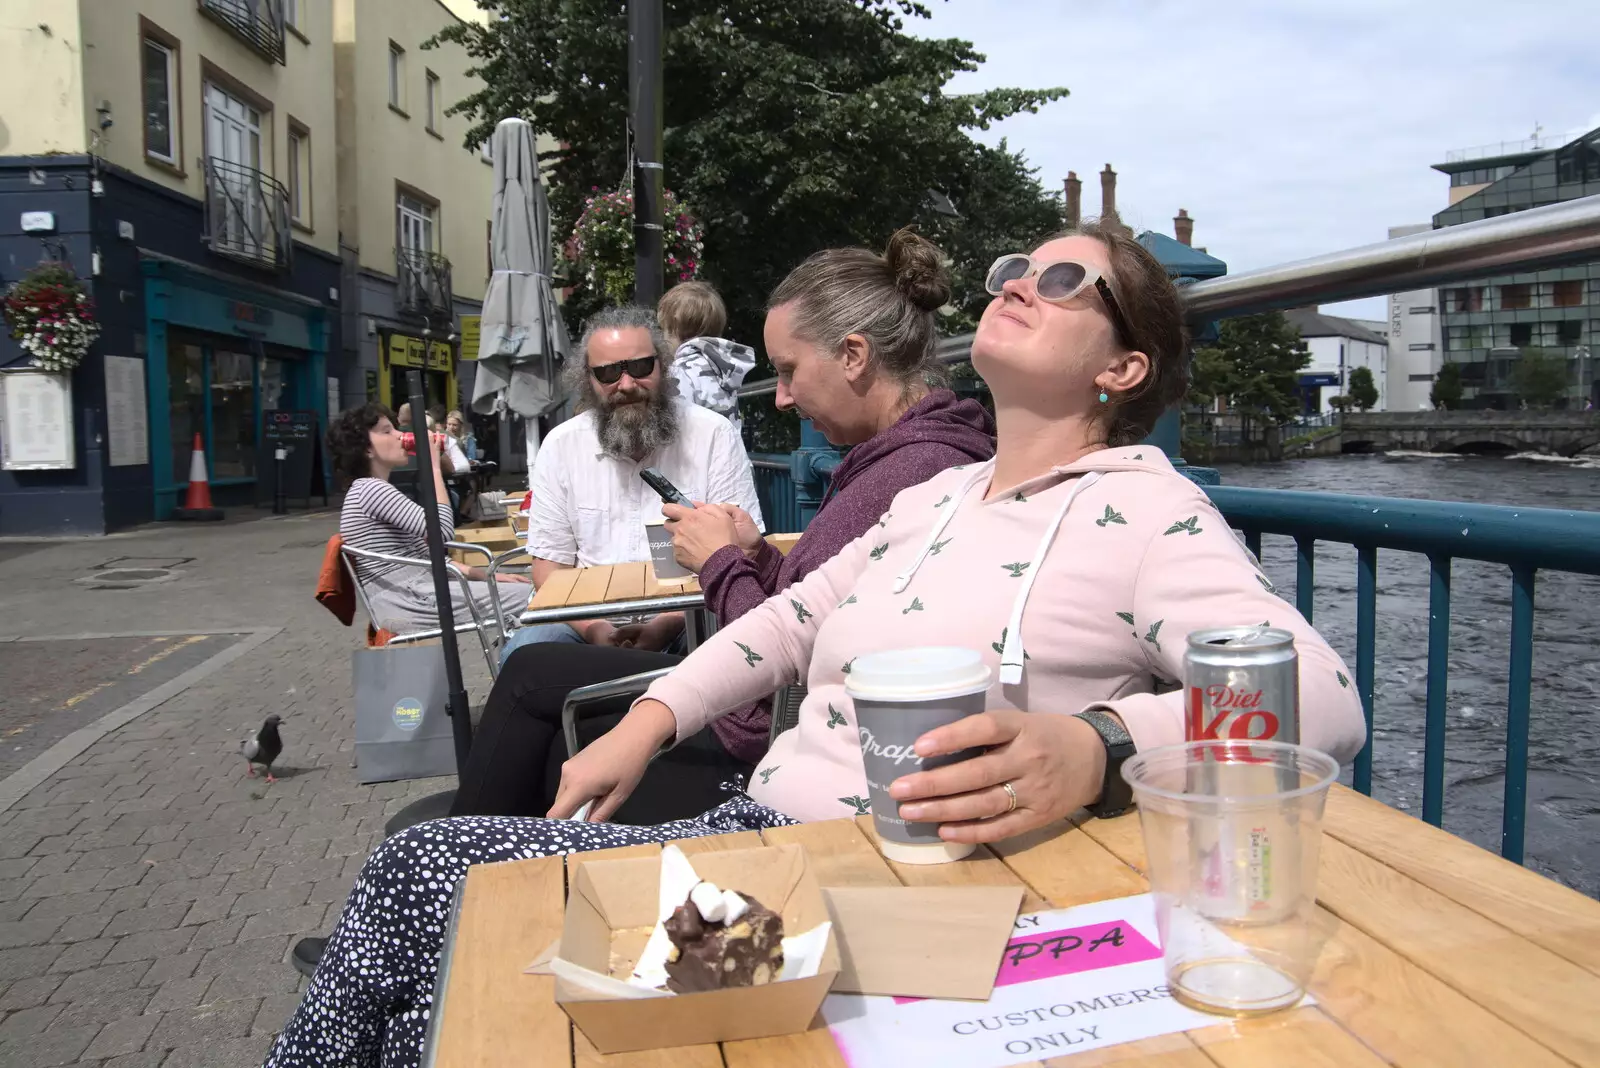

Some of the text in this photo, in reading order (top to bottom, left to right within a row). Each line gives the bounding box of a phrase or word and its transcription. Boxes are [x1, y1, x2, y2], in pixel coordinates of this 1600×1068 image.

[1392, 293, 1404, 337] shouse
[1206, 684, 1264, 708] Diet
[1187, 687, 1280, 763] ke
[1014, 916, 1040, 928] LY
[1006, 927, 1125, 966] PPA
[952, 985, 1175, 1036] CUSTOMERS
[1004, 1025, 1103, 1055] ONLY
